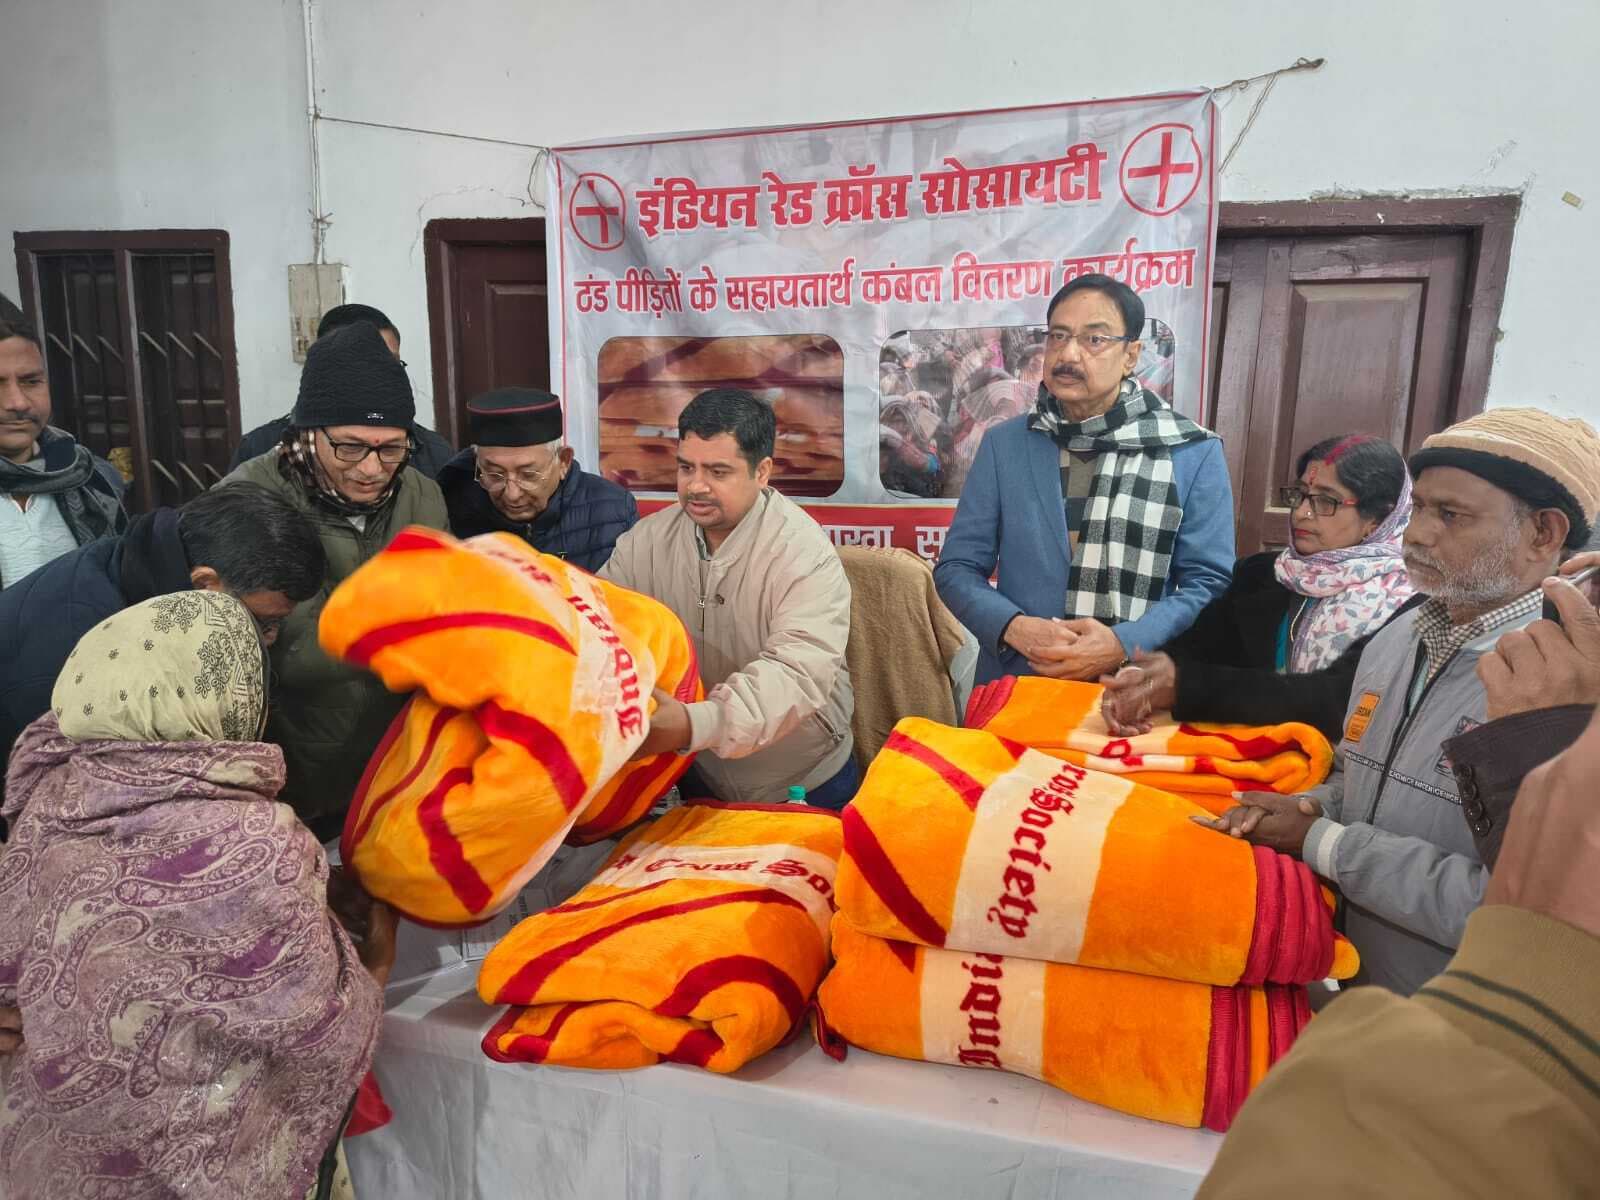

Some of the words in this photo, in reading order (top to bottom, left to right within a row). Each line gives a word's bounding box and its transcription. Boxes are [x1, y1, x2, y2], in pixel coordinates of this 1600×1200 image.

[635, 177, 761, 238] इंडियन
[761, 170, 818, 226] रेड
[823, 163, 913, 226] क्रॉस
[920, 142, 1108, 214] सोसायटी
[573, 273, 611, 313] ठंड
[615, 266, 682, 319] पीड़ितों
[687, 265, 718, 312] के
[724, 257, 855, 312] सहायतार्थ
[860, 261, 944, 304] कंबल
[951, 251, 1056, 302] वितरण
[958, 952, 1003, 1070] Indi
